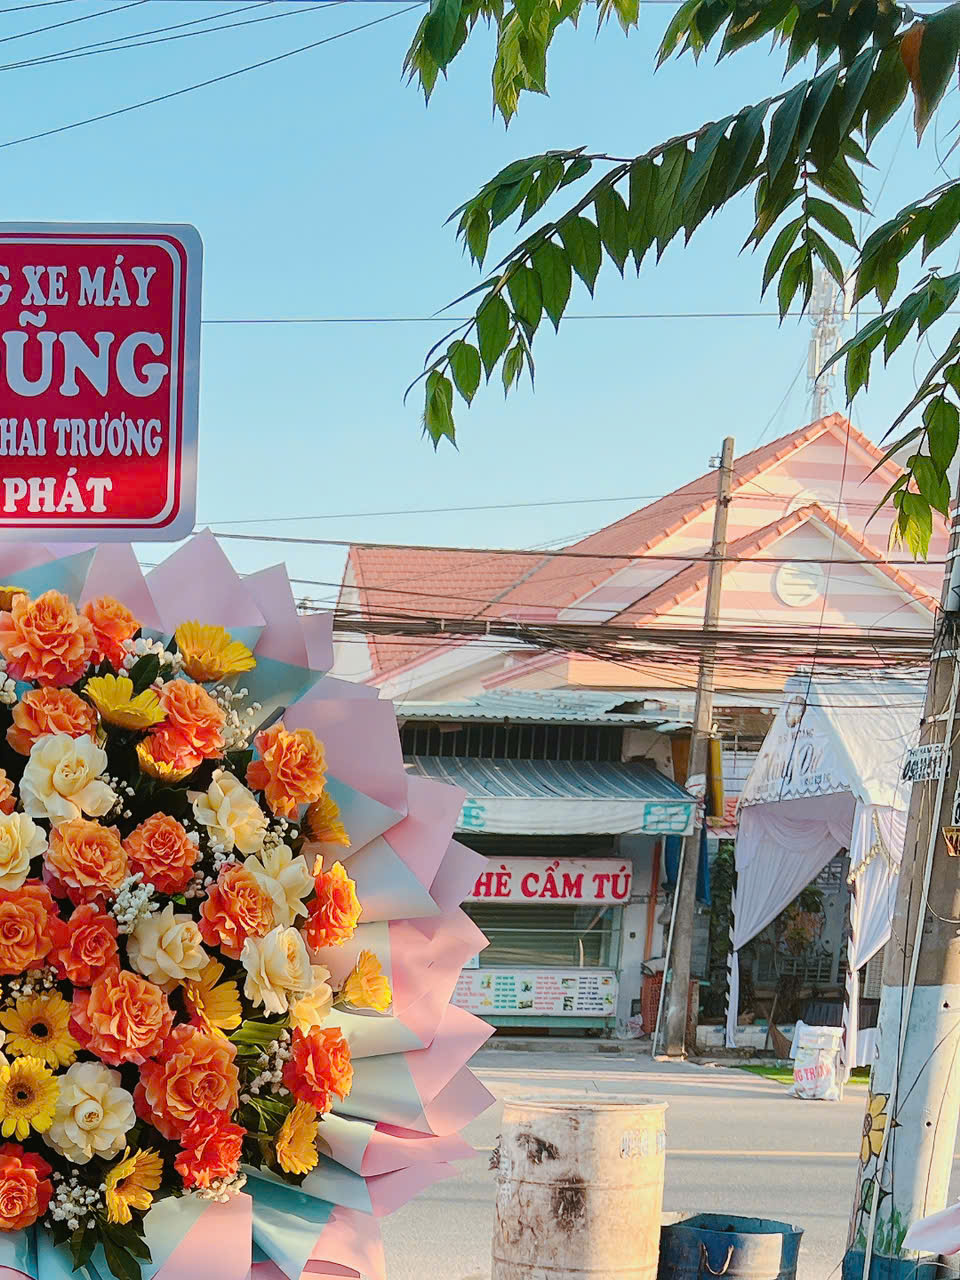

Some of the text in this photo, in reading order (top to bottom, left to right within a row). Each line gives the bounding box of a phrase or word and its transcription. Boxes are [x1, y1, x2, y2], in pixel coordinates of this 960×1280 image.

[22, 265, 69, 307] XE
[78, 254, 157, 307] MÁY
[53, 411, 163, 457] TRƯƠNG
[2, 467, 113, 513] PHÁT
[469, 860, 632, 899] HÈ CẨM TÚ
